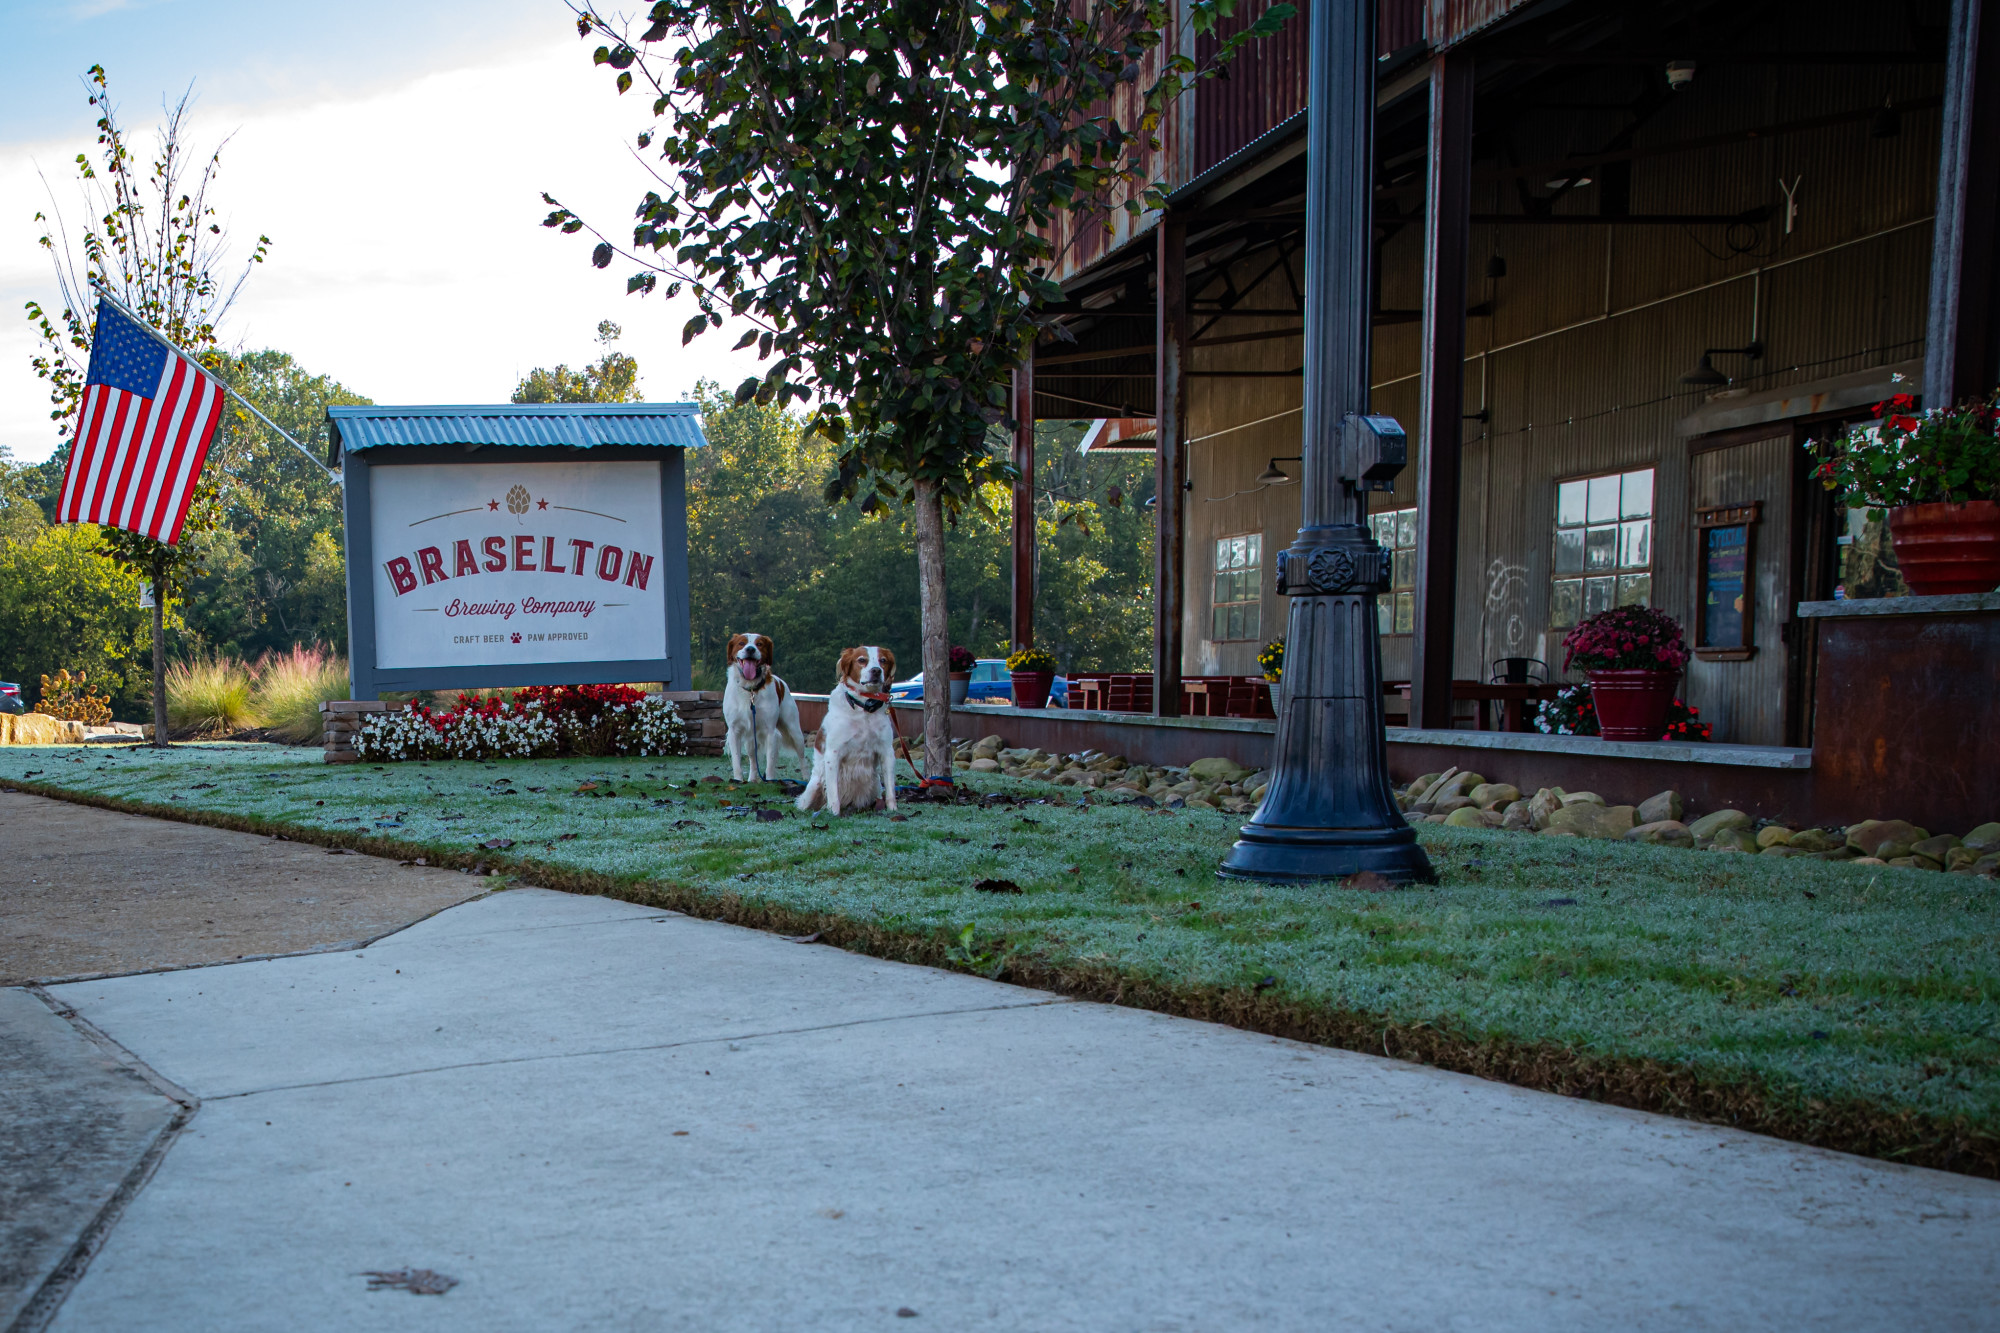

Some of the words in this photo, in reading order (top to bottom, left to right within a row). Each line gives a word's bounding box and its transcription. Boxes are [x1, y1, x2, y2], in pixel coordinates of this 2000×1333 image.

[382, 534, 655, 598] BRASELTON
[444, 598, 517, 620] Brewing
[521, 596, 596, 618] Company
[453, 635, 480, 644] CRAFT
[483, 634, 505, 643] BEER
[527, 633, 545, 642] PAW
[547, 632, 589, 641] APPROVED
